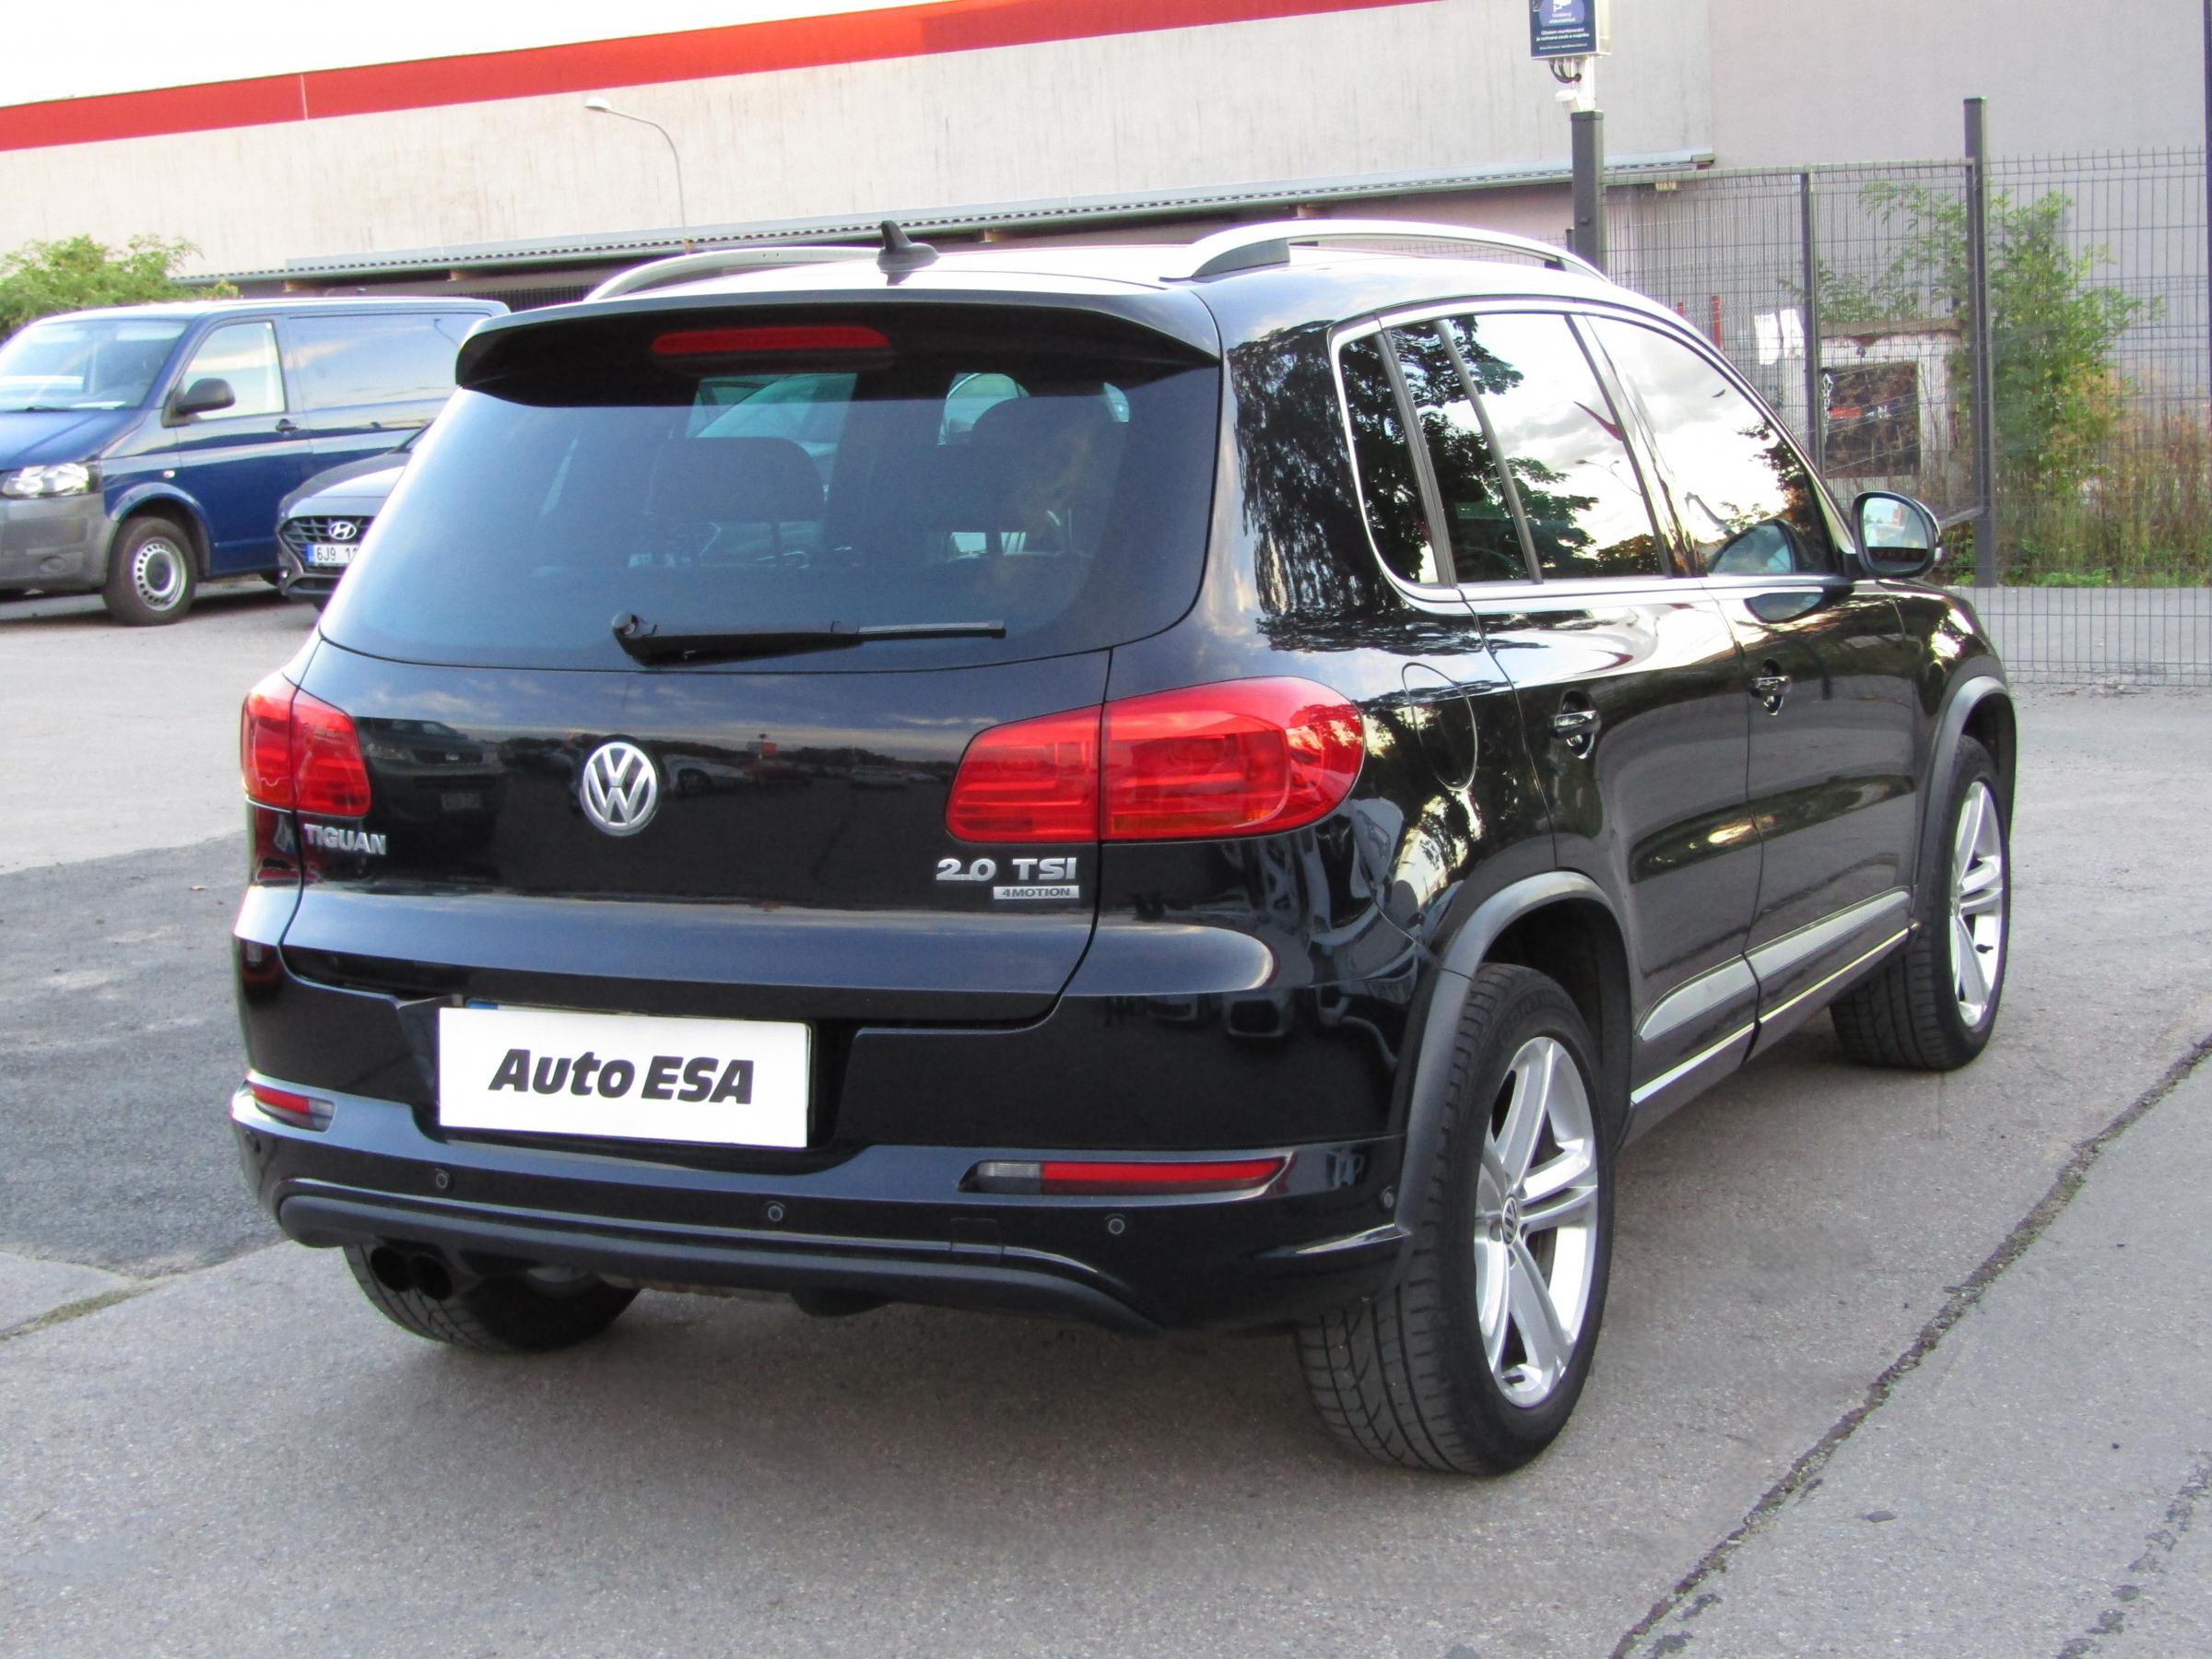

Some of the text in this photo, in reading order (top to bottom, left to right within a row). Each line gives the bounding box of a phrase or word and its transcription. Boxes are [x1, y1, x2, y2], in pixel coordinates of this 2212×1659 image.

[316, 547, 336, 561] 6J9
[304, 823, 386, 855] TIGUAN
[935, 857, 1077, 882] 2.0 TSI
[1002, 888, 1071, 898] 4MOTION
[488, 1049, 755, 1105] Auto ESA
